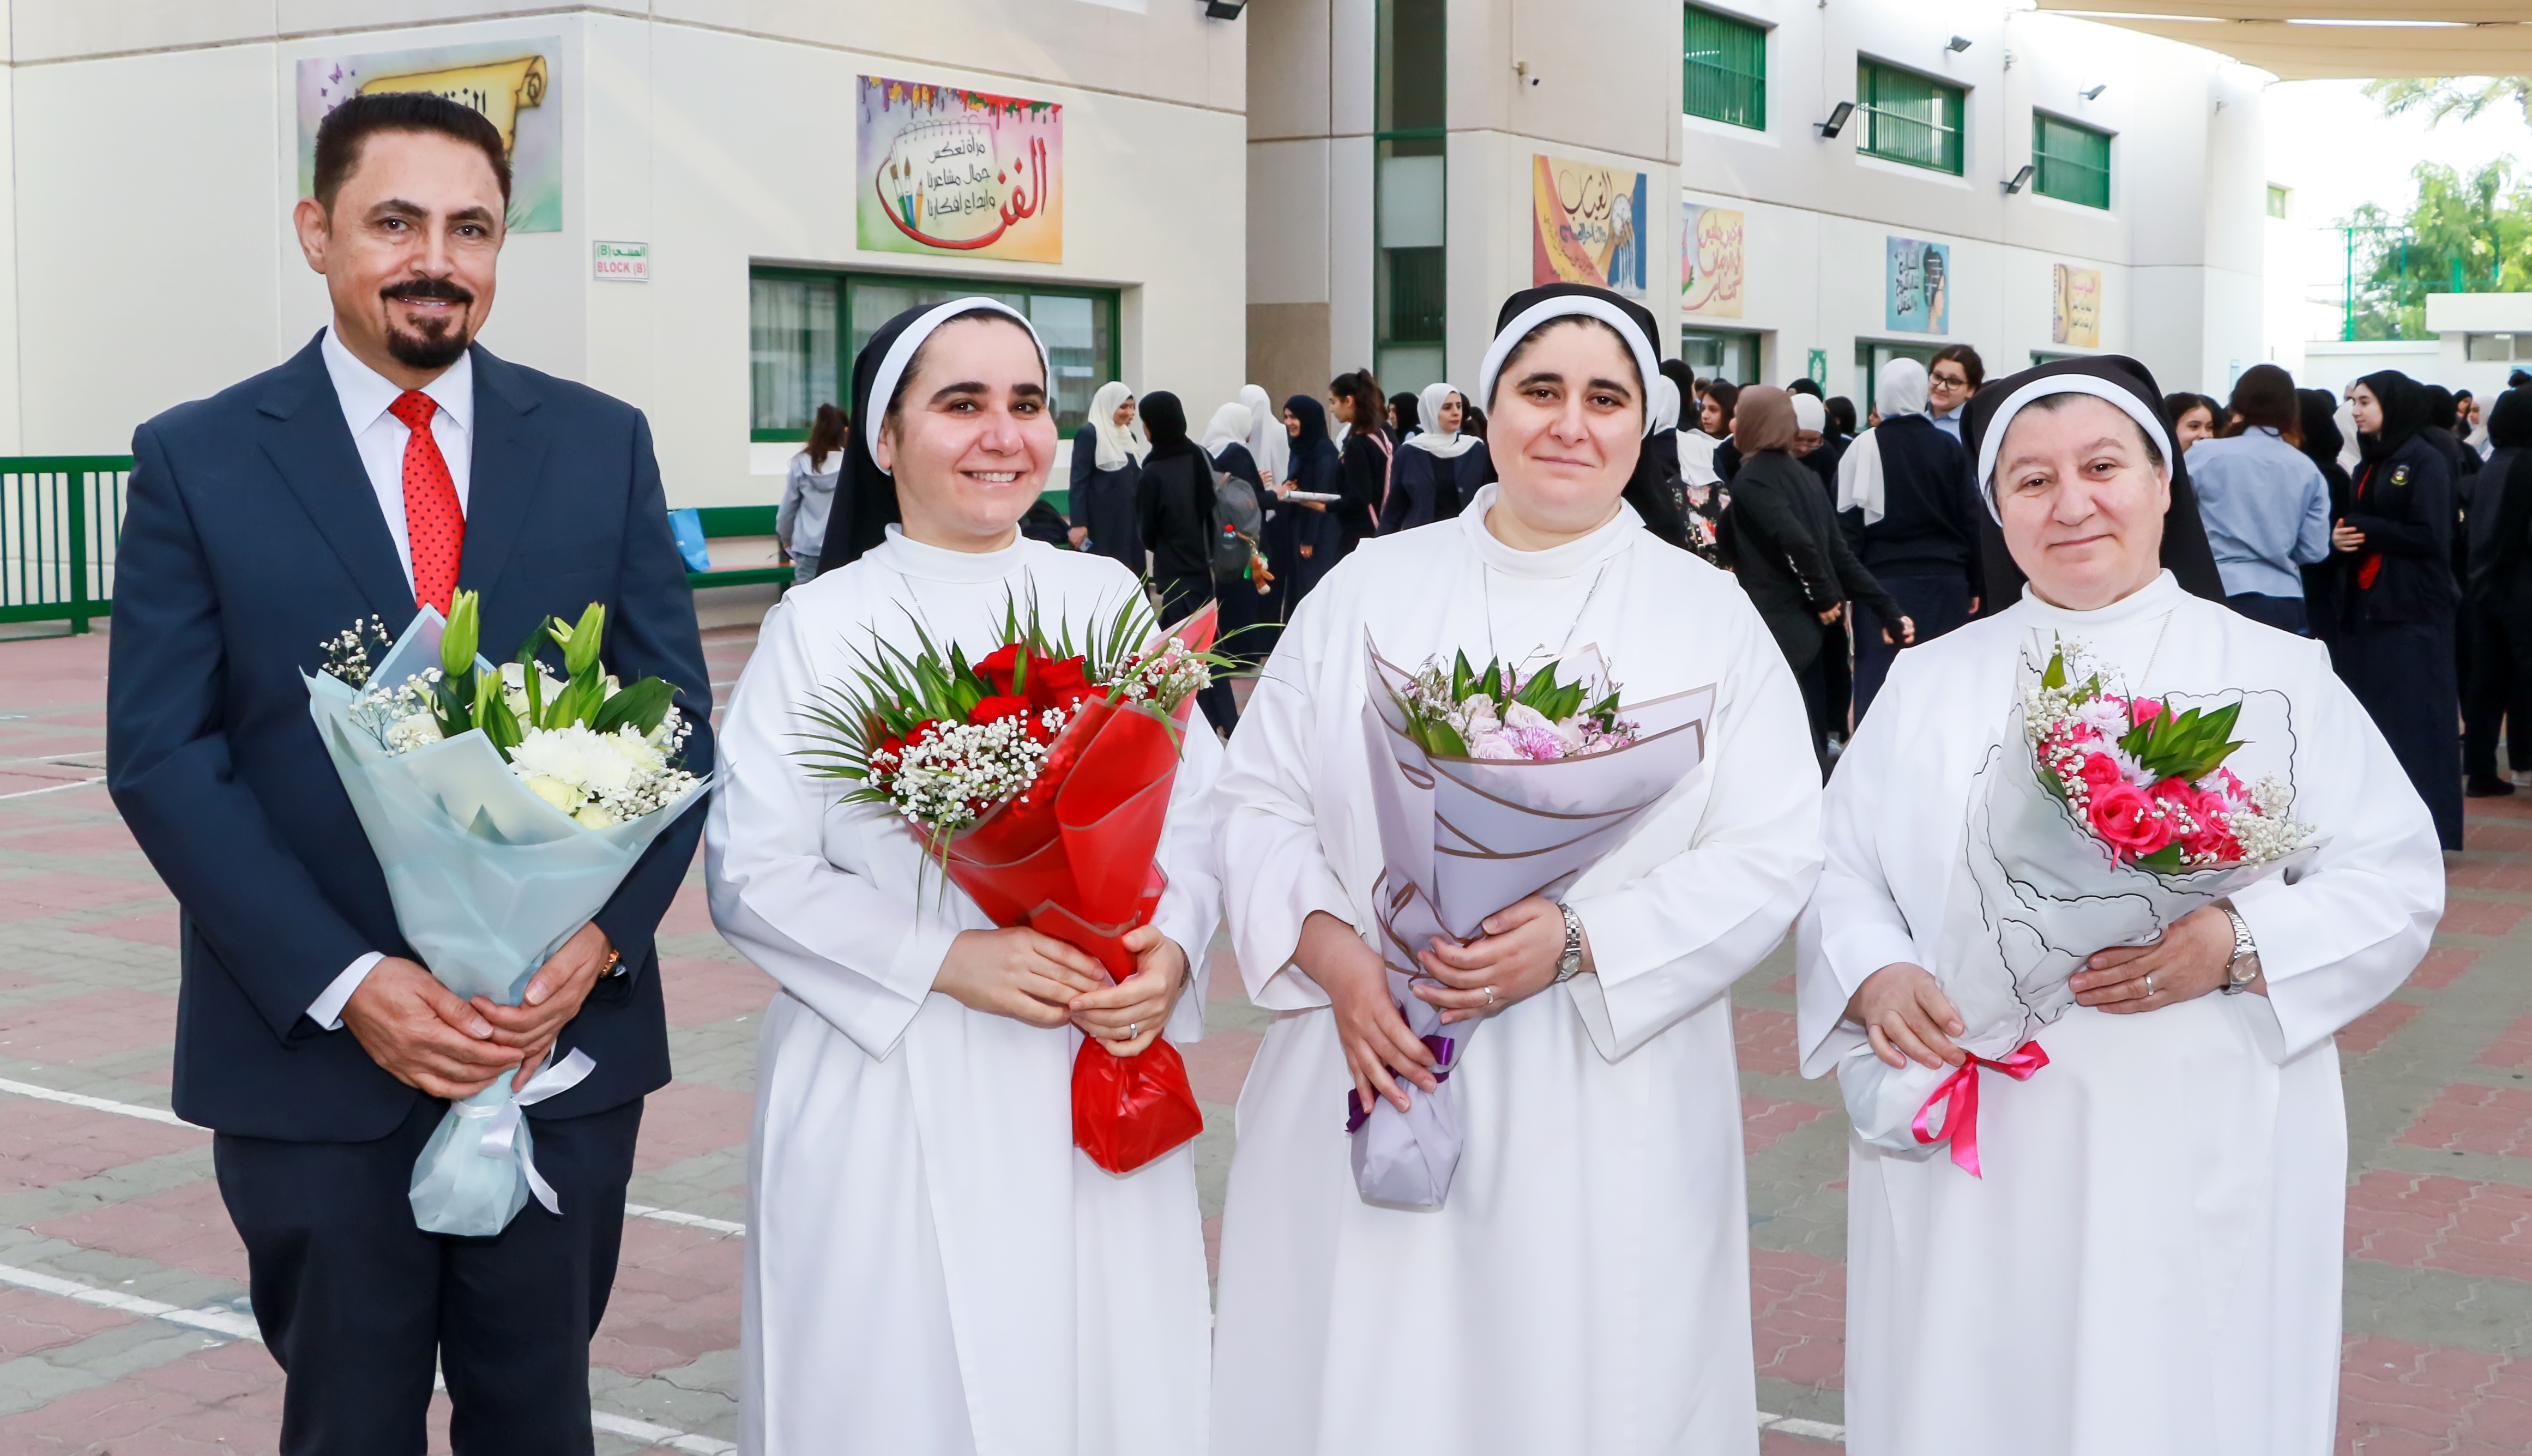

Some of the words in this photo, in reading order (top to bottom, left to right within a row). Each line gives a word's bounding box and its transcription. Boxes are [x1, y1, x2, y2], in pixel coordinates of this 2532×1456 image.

[927, 139, 965, 164] تعكس
[926, 167, 961, 191] مشاعرنا
[963, 162, 991, 184] جمال
[876, 135, 1047, 250] الفن
[1559, 169, 1612, 221] الغياب
[597, 244, 611, 258] (B)
[597, 261, 630, 273] BLOCK
[633, 262, 647, 276] (B)
